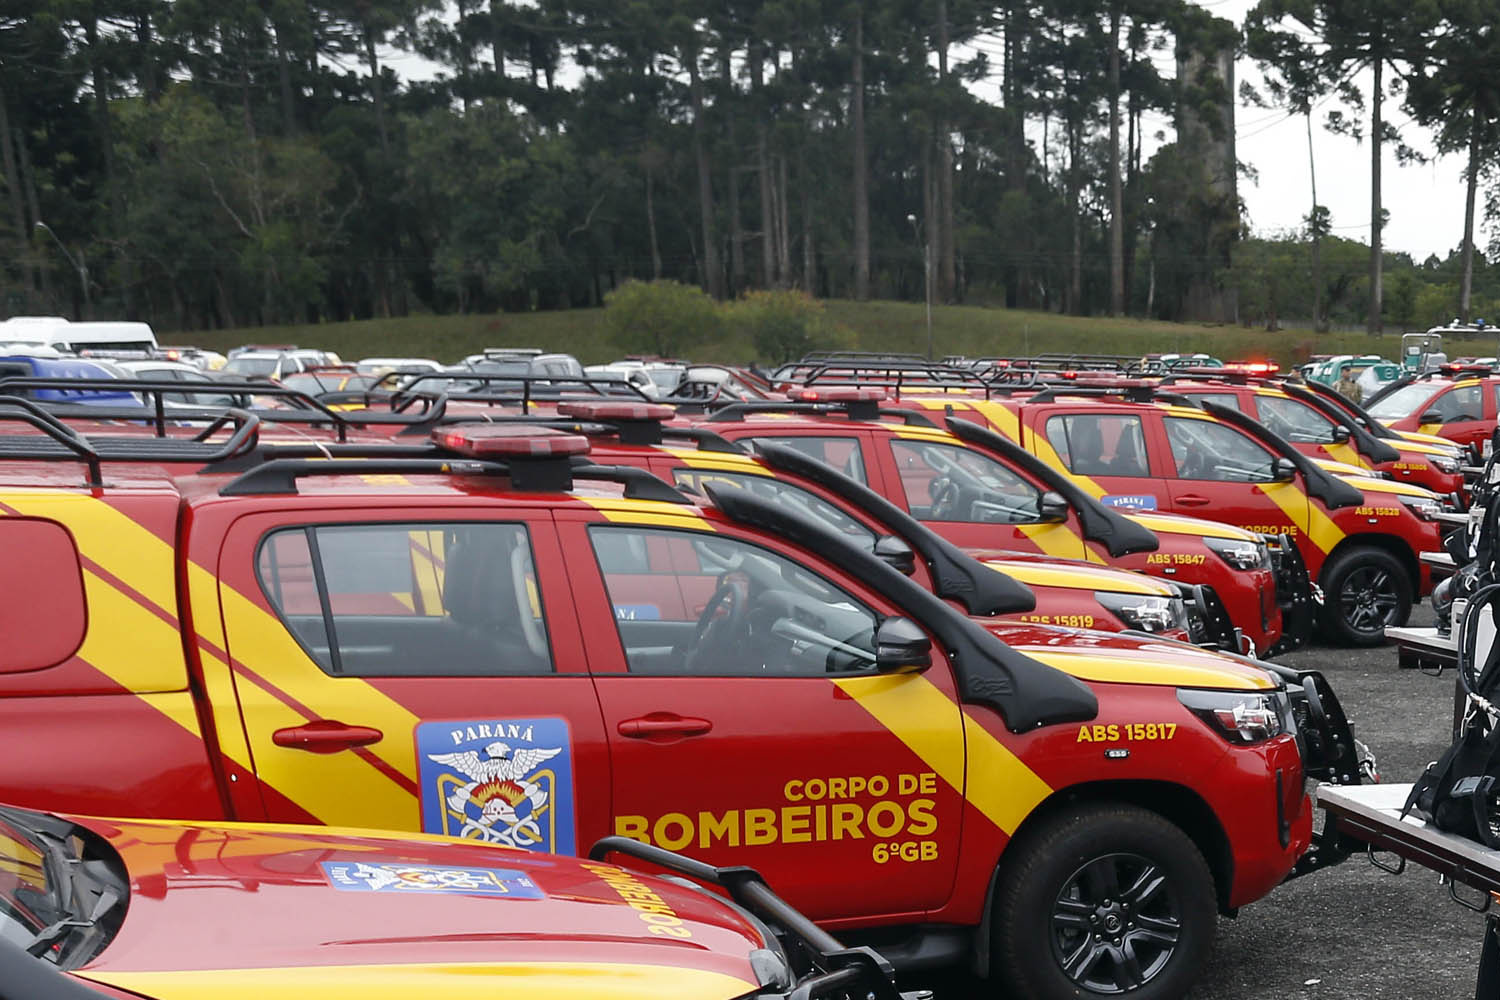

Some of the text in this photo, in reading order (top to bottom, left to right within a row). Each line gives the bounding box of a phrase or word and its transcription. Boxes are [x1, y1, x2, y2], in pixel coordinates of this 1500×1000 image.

[1355, 507, 1374, 515] ABS
[1241, 525, 1297, 536] ORPO DE
[1147, 554, 1205, 565] ABS 15847
[1053, 615, 1094, 628] 15819
[451, 724, 534, 745] PARANÁ
[1077, 723, 1177, 742] ABS 15817
[784, 773, 937, 801] CORPO DE
[614, 798, 938, 853] BOMBEIROS
